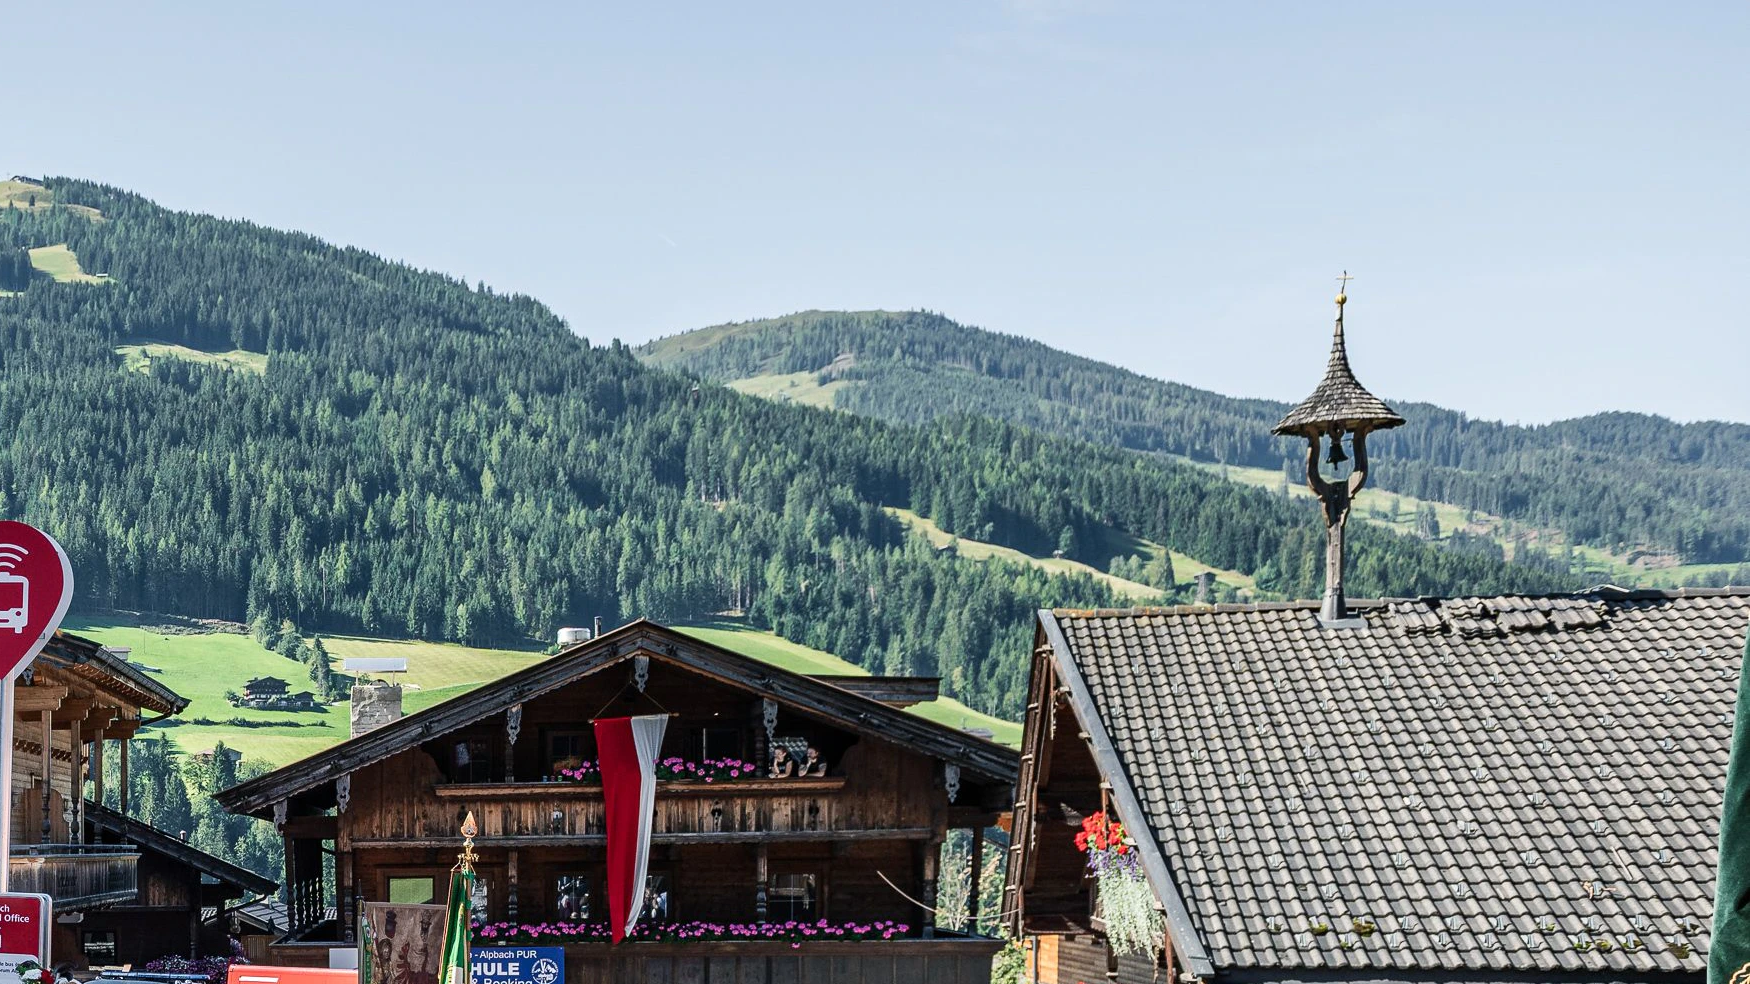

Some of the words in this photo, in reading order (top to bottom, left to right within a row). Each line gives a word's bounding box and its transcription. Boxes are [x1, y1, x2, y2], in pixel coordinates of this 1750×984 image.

[4, 914, 30, 923] Office
[479, 950, 515, 960] Alpbach
[516, 950, 537, 959] PUR
[471, 962, 520, 976] HULE
